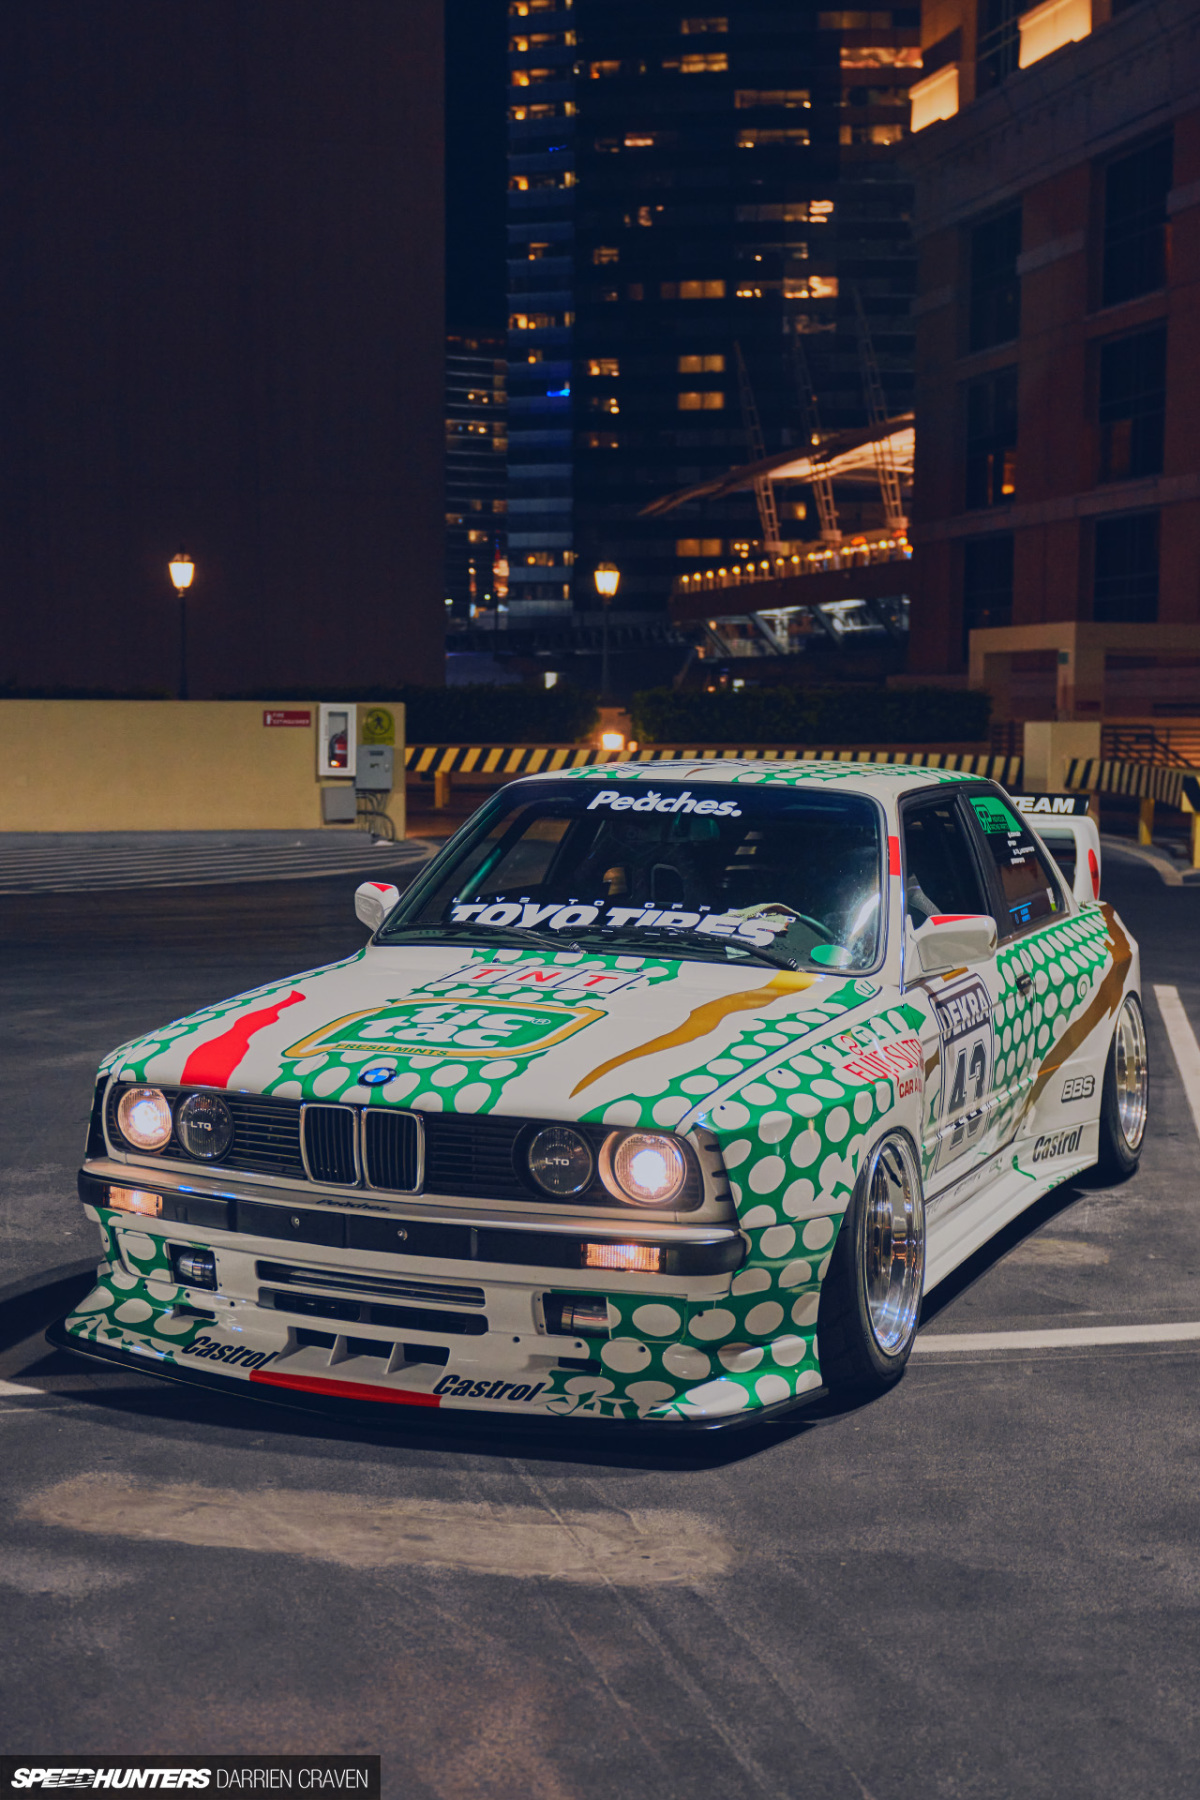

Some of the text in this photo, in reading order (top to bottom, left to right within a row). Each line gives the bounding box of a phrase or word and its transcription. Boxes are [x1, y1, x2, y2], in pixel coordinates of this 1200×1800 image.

[451, 903, 600, 930] TOYO
[568, 899, 605, 907] TO
[472, 968, 619, 987] TNT
[410, 1003, 535, 1031] tic
[937, 987, 991, 1041] DEKRA
[358, 1015, 513, 1048] tac
[335, 1043, 449, 1056] FRESH MINTS
[1061, 1074, 1096, 1104] BBS
[1032, 1124, 1084, 1163] Castrol
[545, 1157, 570, 1167] LTO
[181, 1335, 281, 1370] Castrol
[433, 1373, 547, 1402] Castrol
